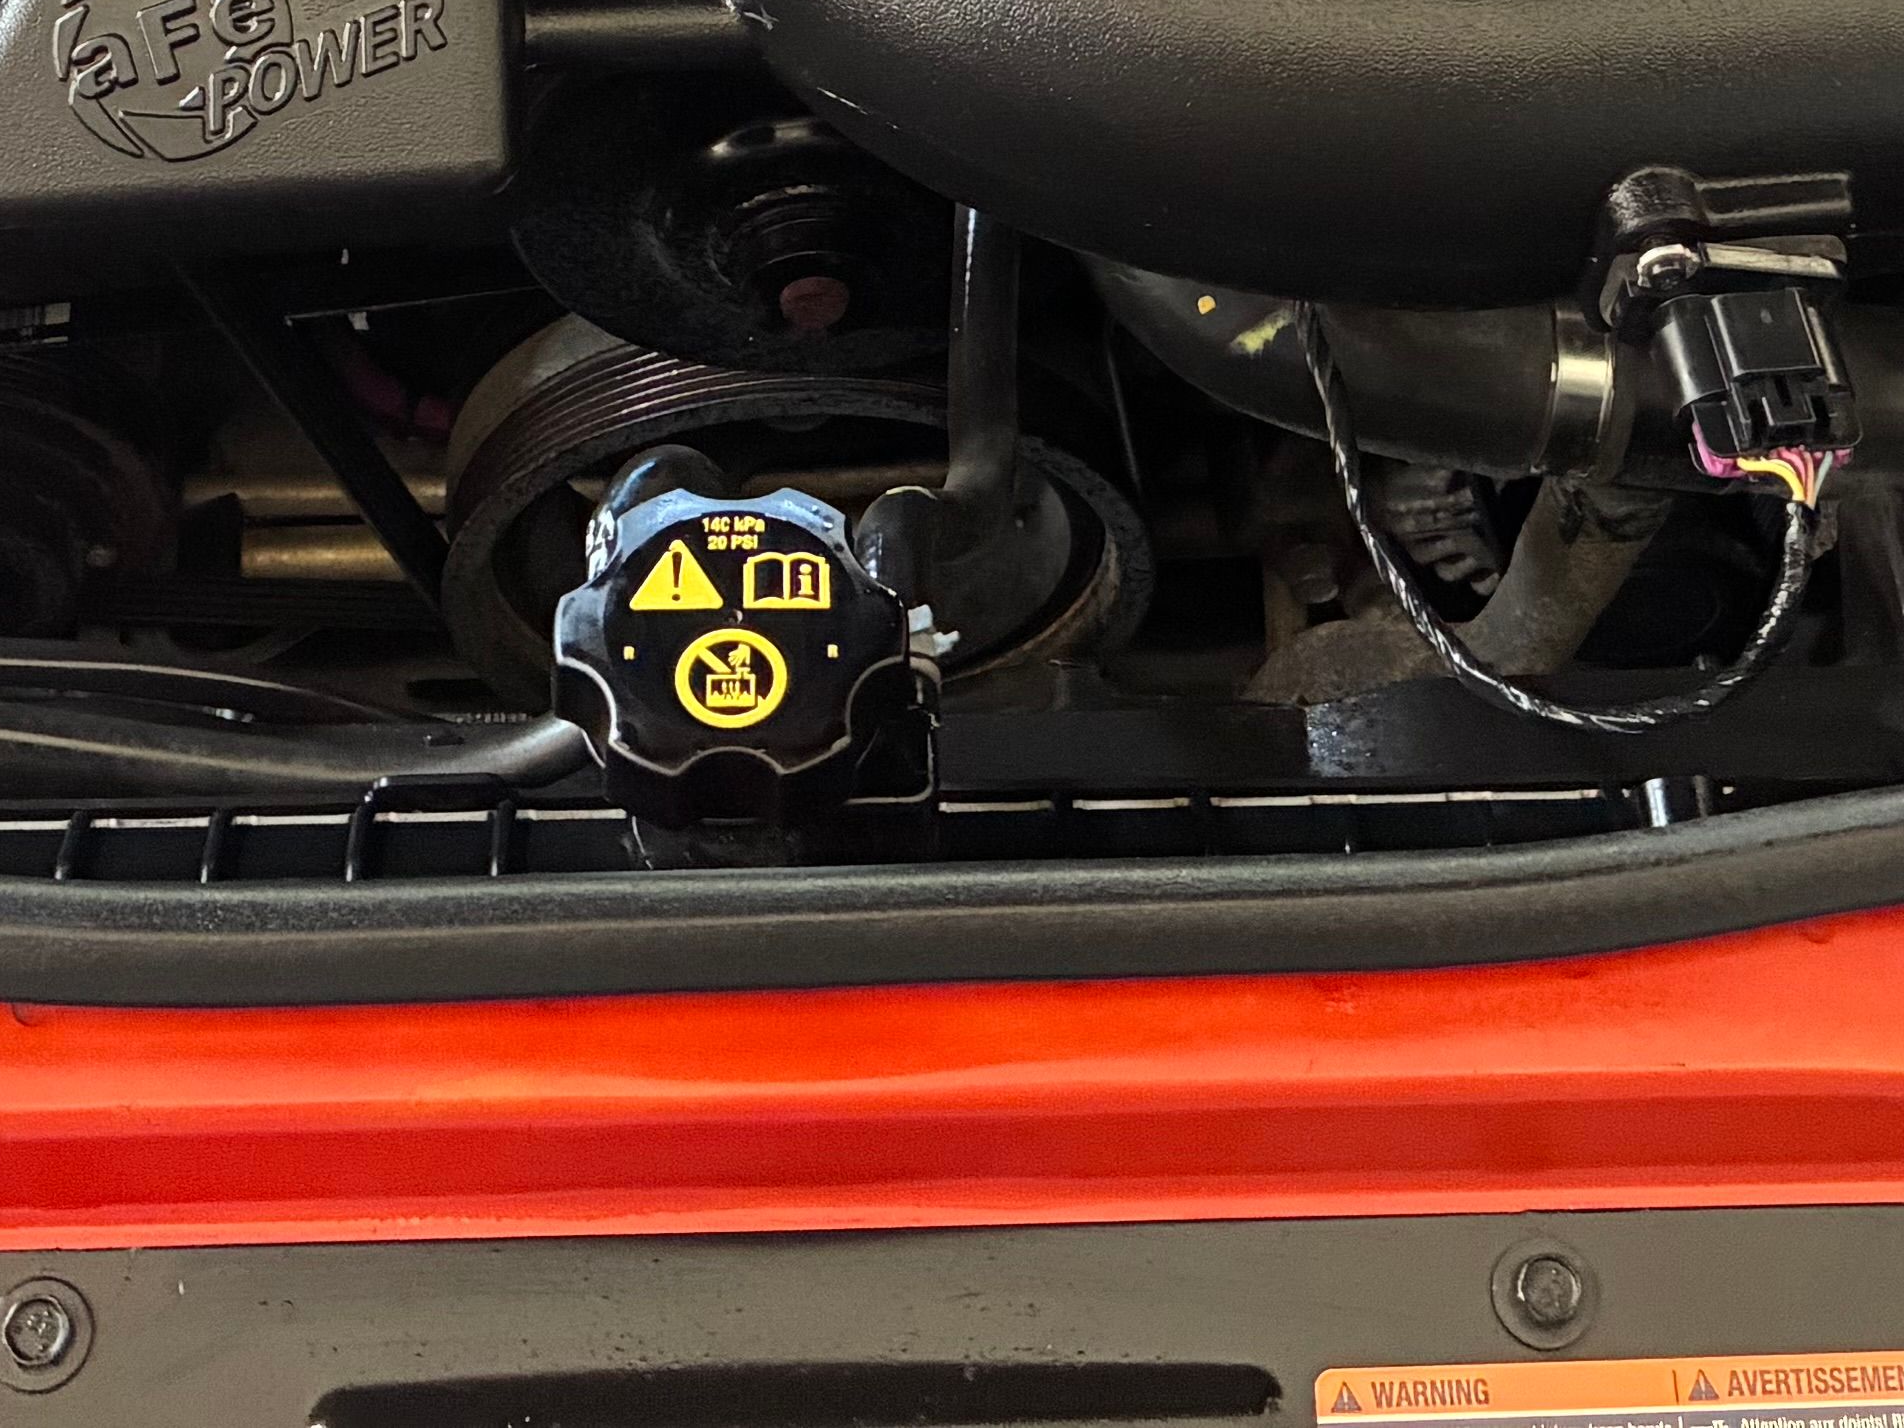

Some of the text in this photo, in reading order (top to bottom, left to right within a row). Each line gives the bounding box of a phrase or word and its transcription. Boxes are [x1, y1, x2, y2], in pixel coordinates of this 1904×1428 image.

[707, 534, 759, 551] 20 PSI
[1371, 1377, 1491, 1411] WARNING
